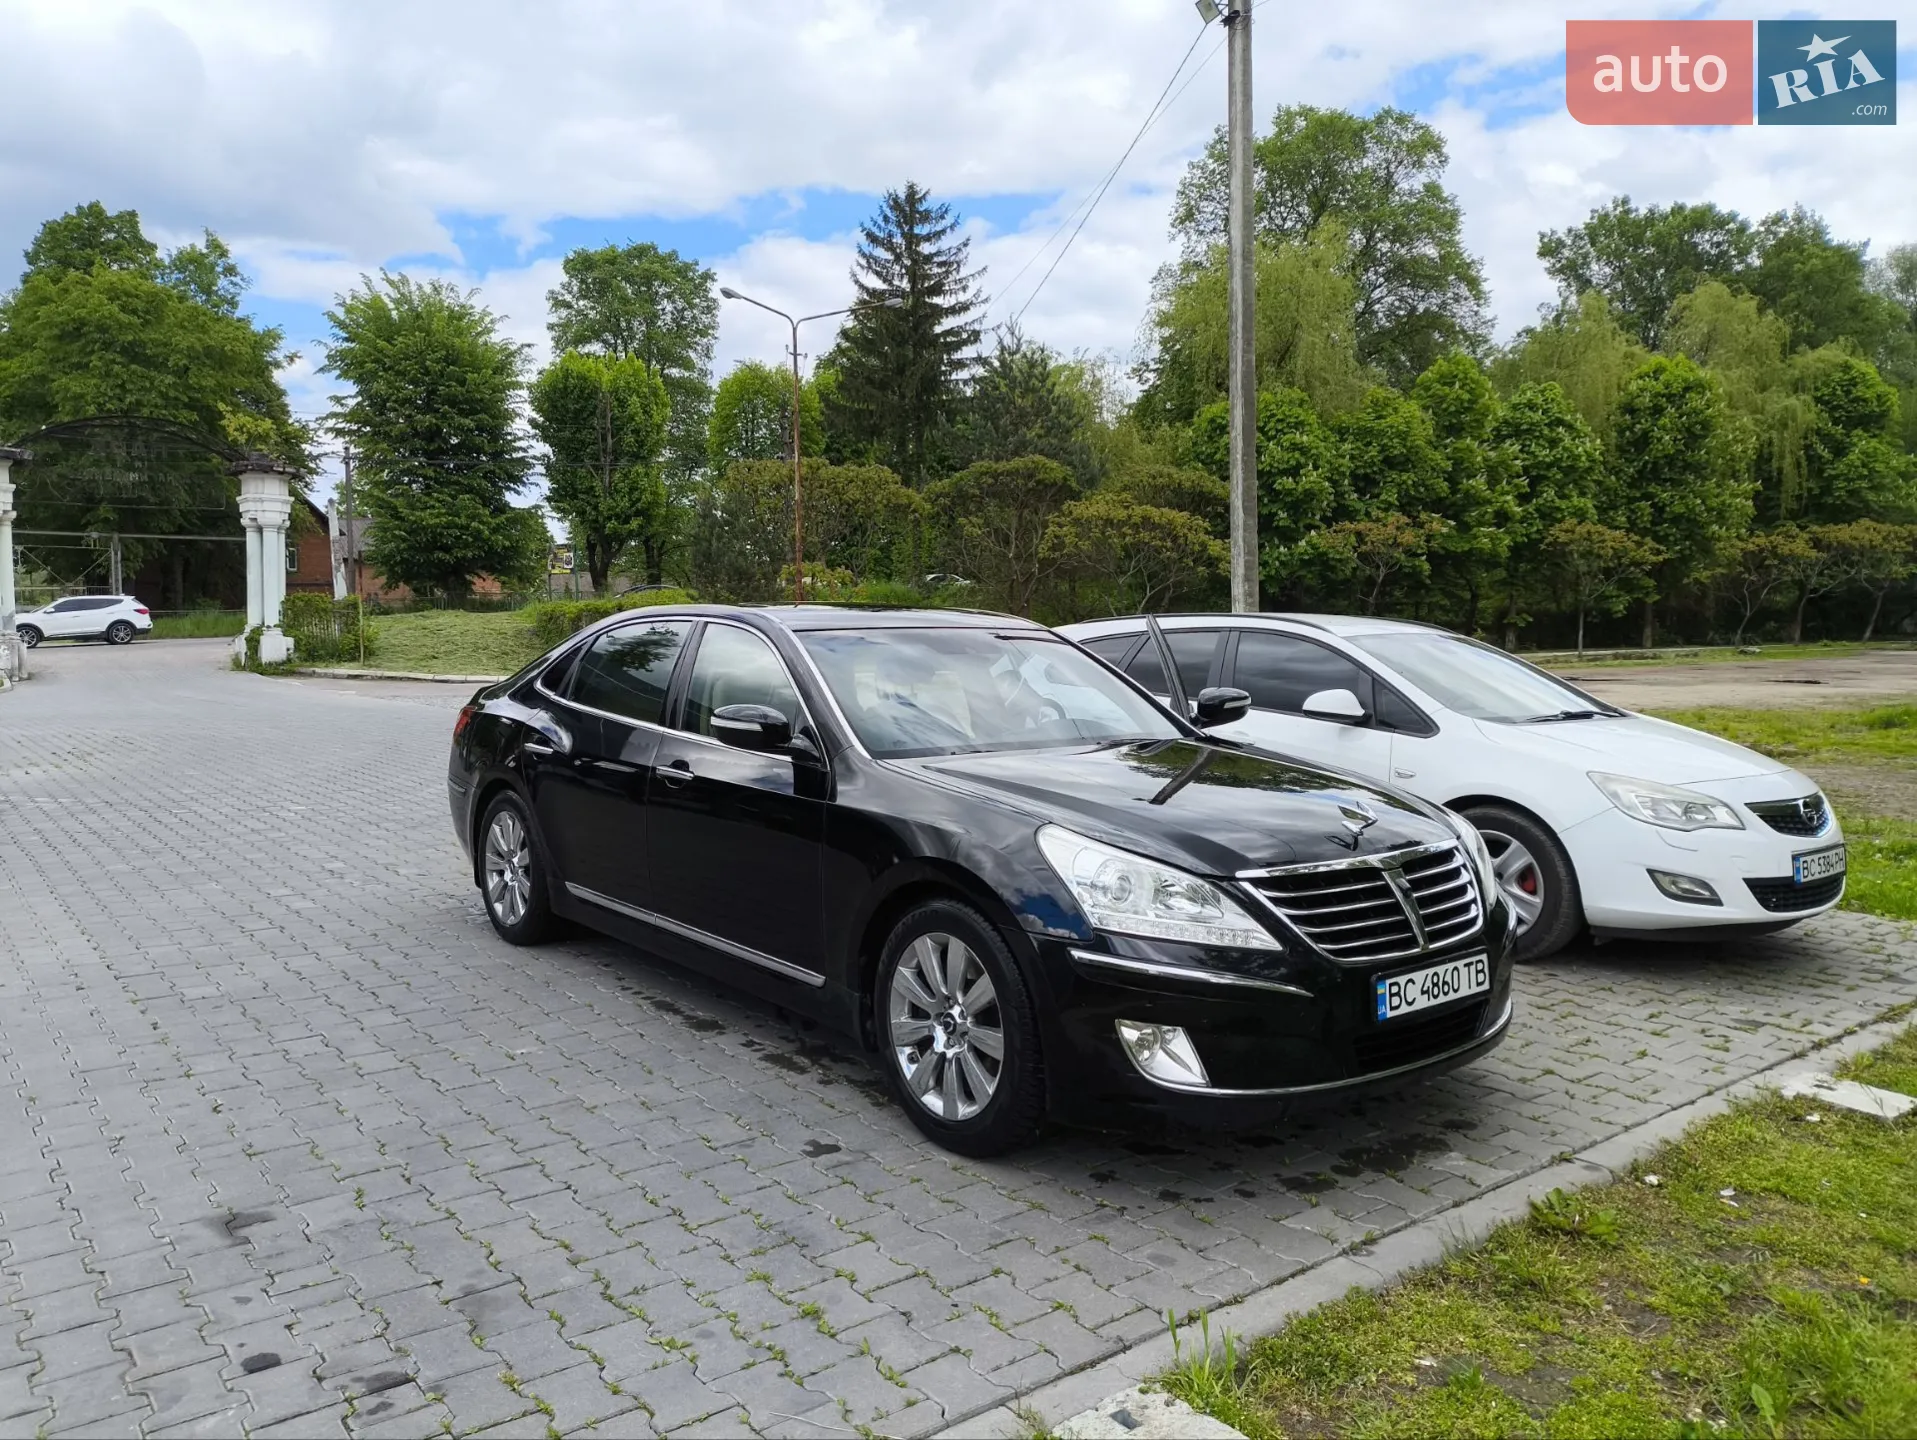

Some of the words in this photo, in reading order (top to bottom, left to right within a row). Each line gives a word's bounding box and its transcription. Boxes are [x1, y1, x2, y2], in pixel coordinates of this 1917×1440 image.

[1802, 859, 1816, 879] BC
[1817, 852, 1835, 875] 5384
[1835, 849, 1845, 870] PH
[1388, 978, 1417, 1012] BC
[1420, 965, 1461, 1002] 4860
[1463, 958, 1487, 990] TB
[1377, 1003, 1387, 1015] UA
